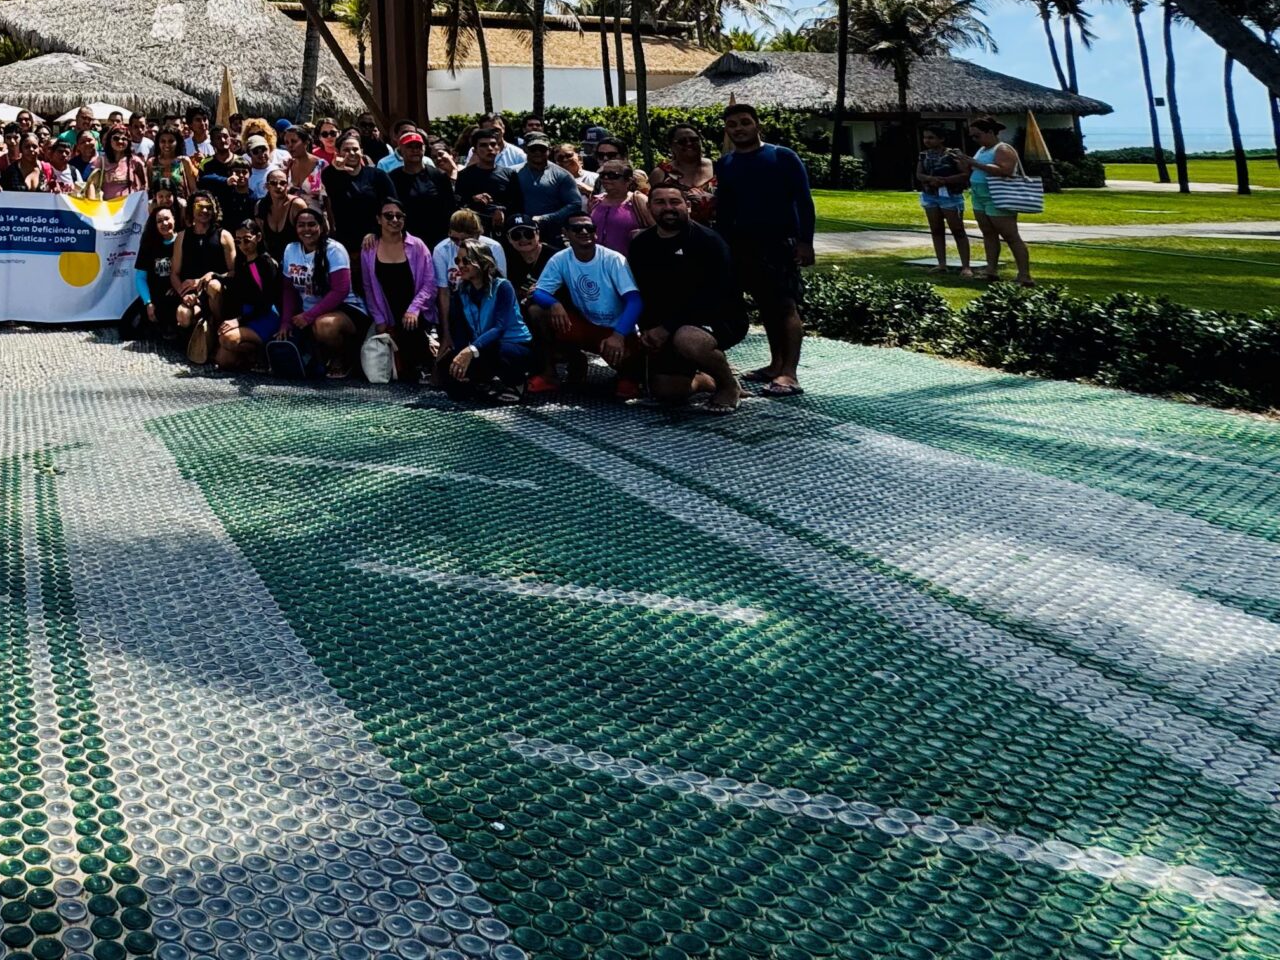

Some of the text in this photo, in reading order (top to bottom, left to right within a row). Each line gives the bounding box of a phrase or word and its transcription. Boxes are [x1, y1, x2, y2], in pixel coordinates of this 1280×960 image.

[20, 215, 47, 224] edição
[31, 225, 75, 234] Deficiência
[9, 234, 47, 243] Turísticas
[54, 236, 77, 244] DNPD
